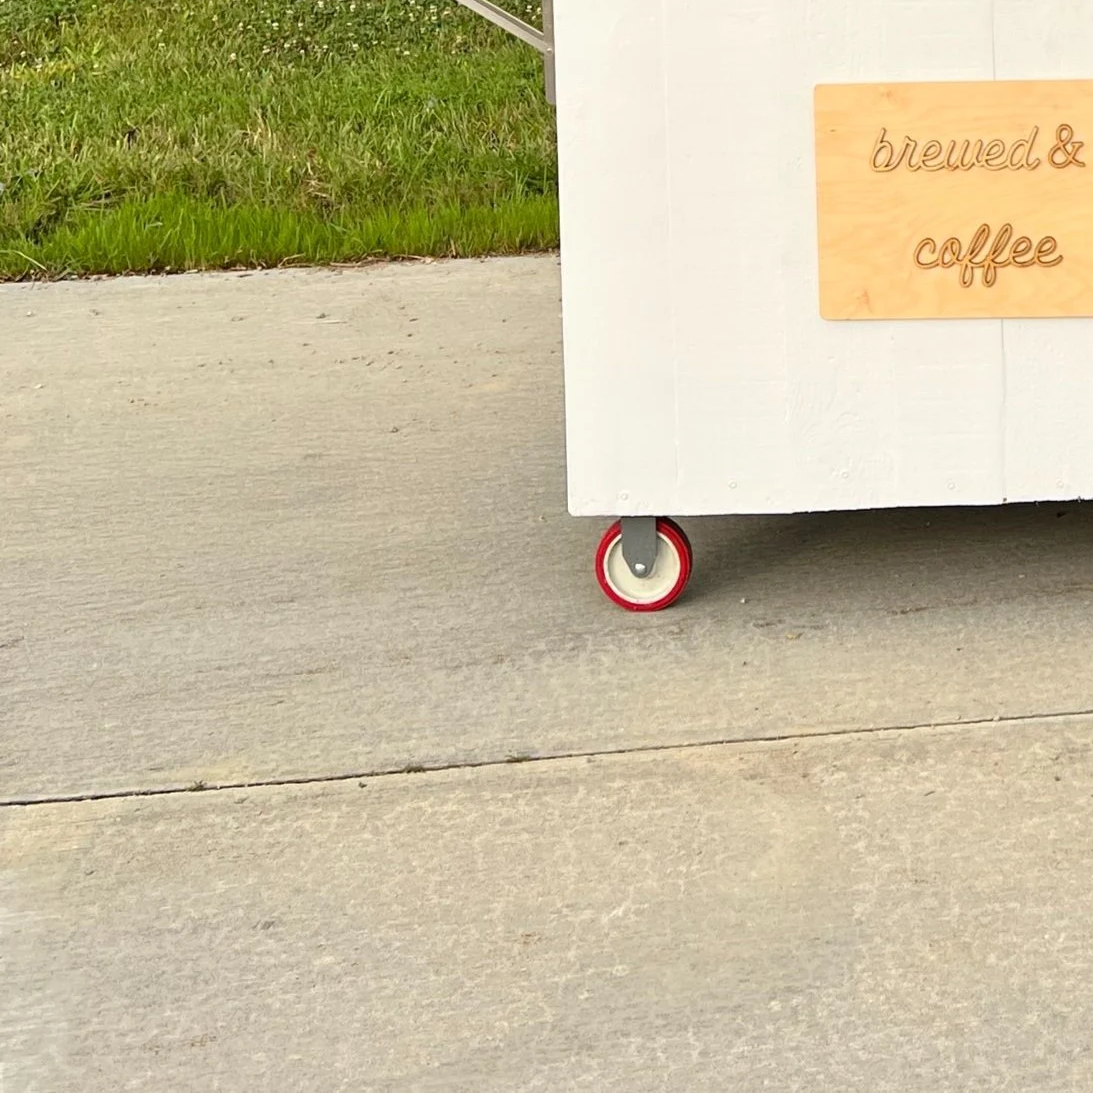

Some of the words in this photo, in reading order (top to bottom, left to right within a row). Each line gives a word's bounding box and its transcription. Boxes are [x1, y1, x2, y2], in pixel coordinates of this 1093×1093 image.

[870, 126, 1041, 173] brewed
[1047, 123, 1086, 168] &
[913, 223, 1063, 288] coffee
